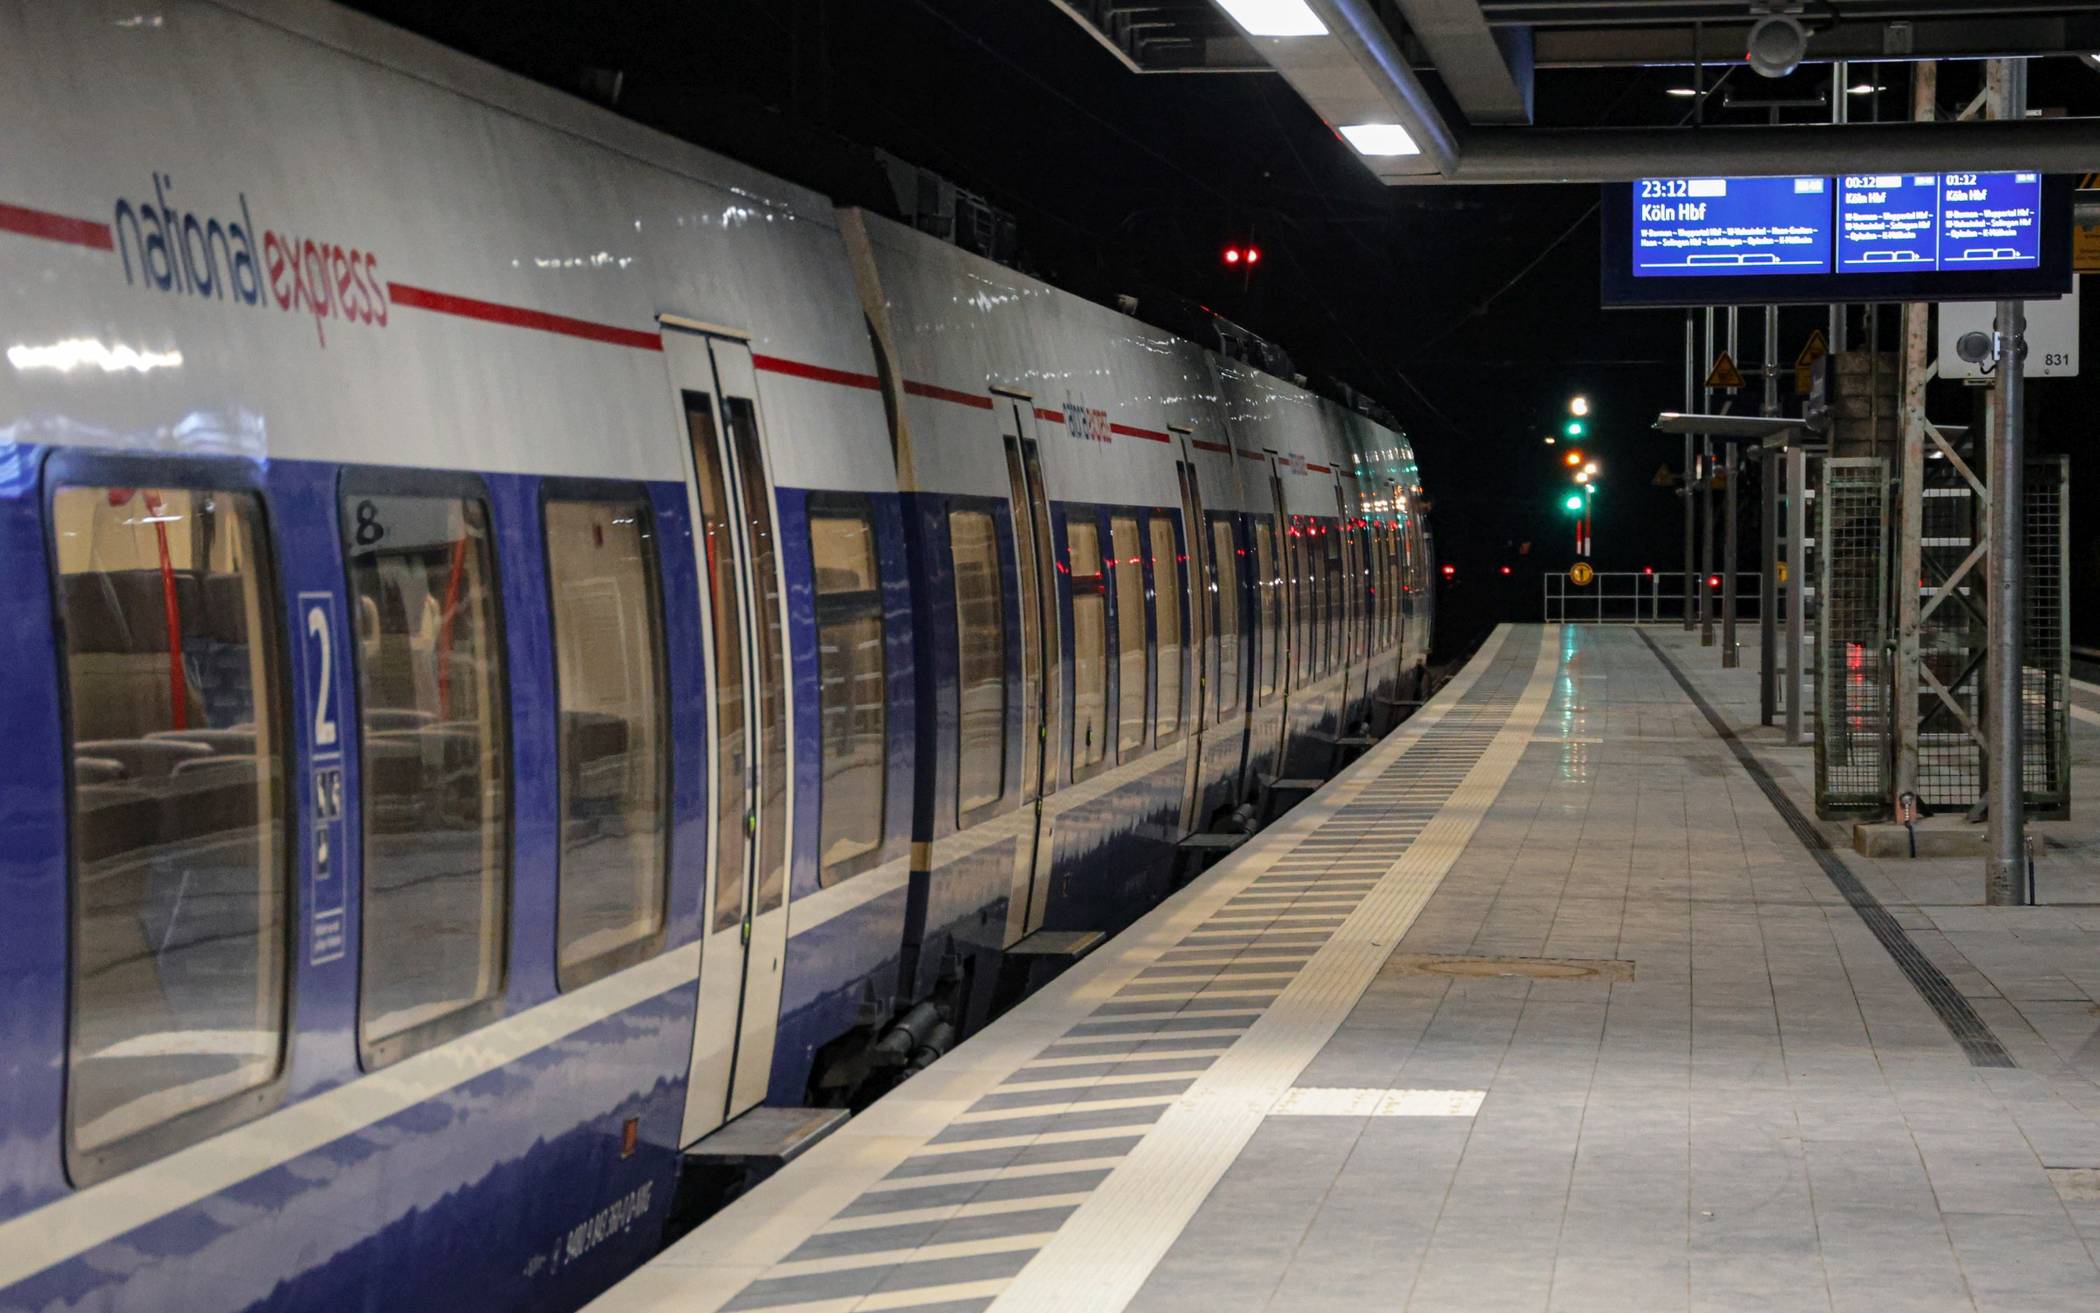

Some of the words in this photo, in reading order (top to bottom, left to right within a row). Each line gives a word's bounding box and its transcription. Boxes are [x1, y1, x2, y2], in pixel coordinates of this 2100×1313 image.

[1641, 180, 1687, 198] 23:12
[1946, 174, 1977, 186] 01:12
[1946, 189, 1968, 201] Köln
[1969, 188, 1988, 201] Hbf
[1641, 204, 1675, 222] Köln
[1678, 202, 1707, 221] Hbf
[115, 172, 267, 308] national
[264, 230, 388, 348] express
[2045, 354, 2069, 366] 831
[356, 499, 384, 546] 8
[308, 606, 337, 745] 2
